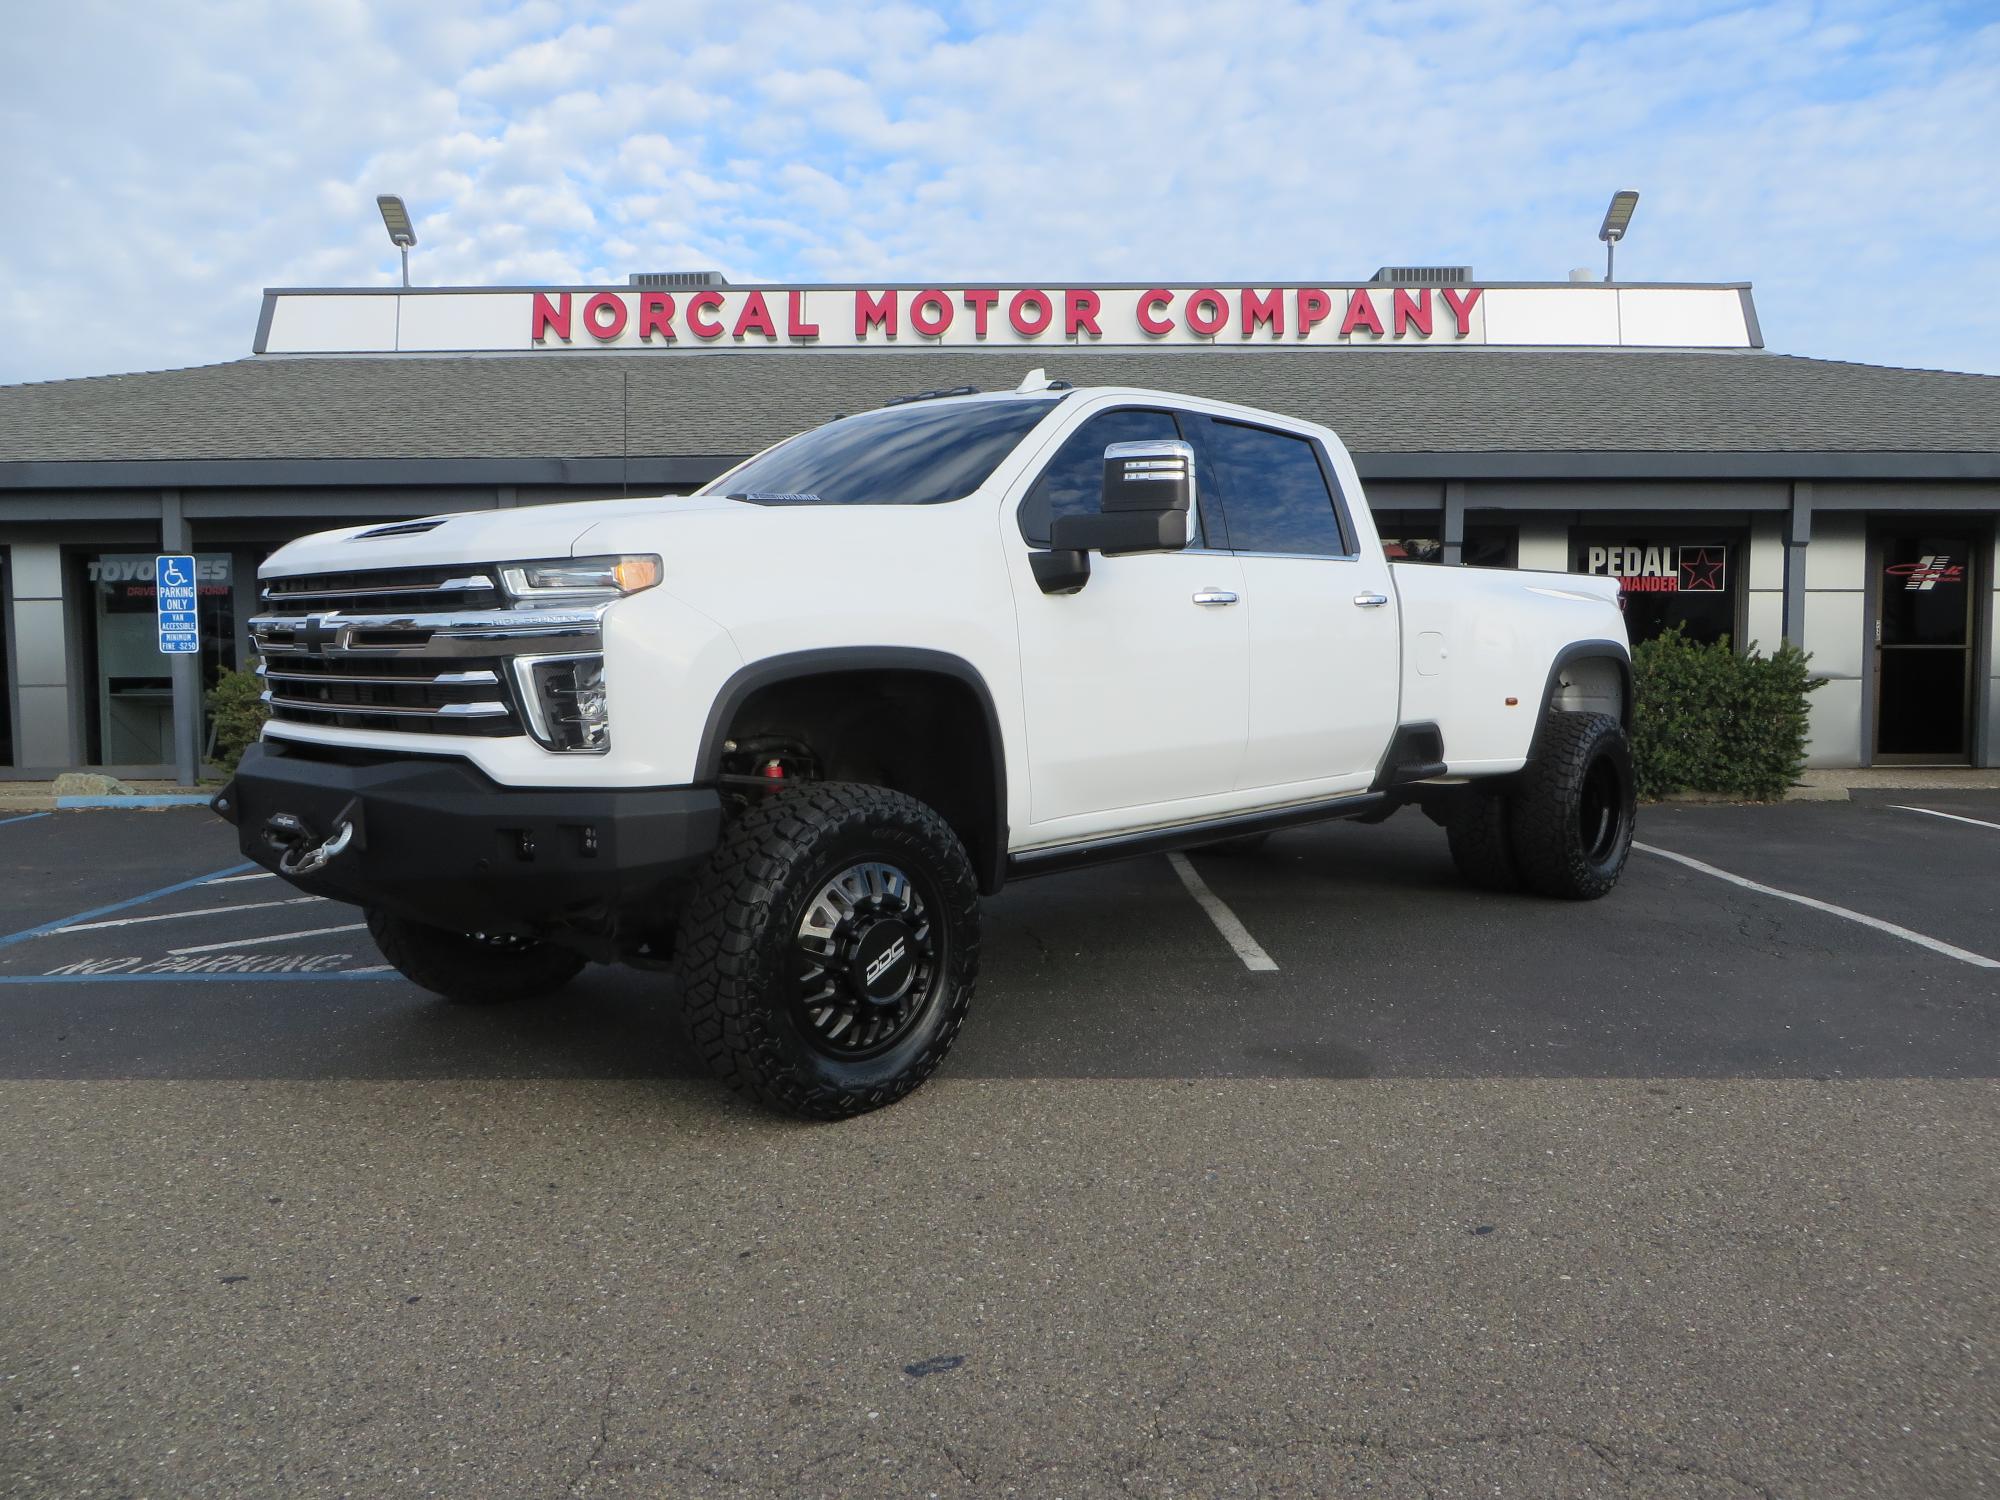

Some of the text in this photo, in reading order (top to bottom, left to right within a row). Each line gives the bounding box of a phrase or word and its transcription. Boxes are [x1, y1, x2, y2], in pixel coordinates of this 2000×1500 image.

[532, 288, 1484, 343] NORCAL MOTOR COMPANY
[1588, 547, 1678, 577] PEDAL
[88, 560, 156, 581] TOYO
[1617, 576, 1678, 592] MANDER
[159, 586, 194, 598] PARKING
[166, 599, 188, 610] ONLY
[171, 613, 184, 621] VAN
[161, 622, 195, 630] ACCESSIBLE
[166, 633, 192, 641] MINIMUM
[162, 642, 176, 650] FINE
[43, 954, 353, 975] NO PARKING
